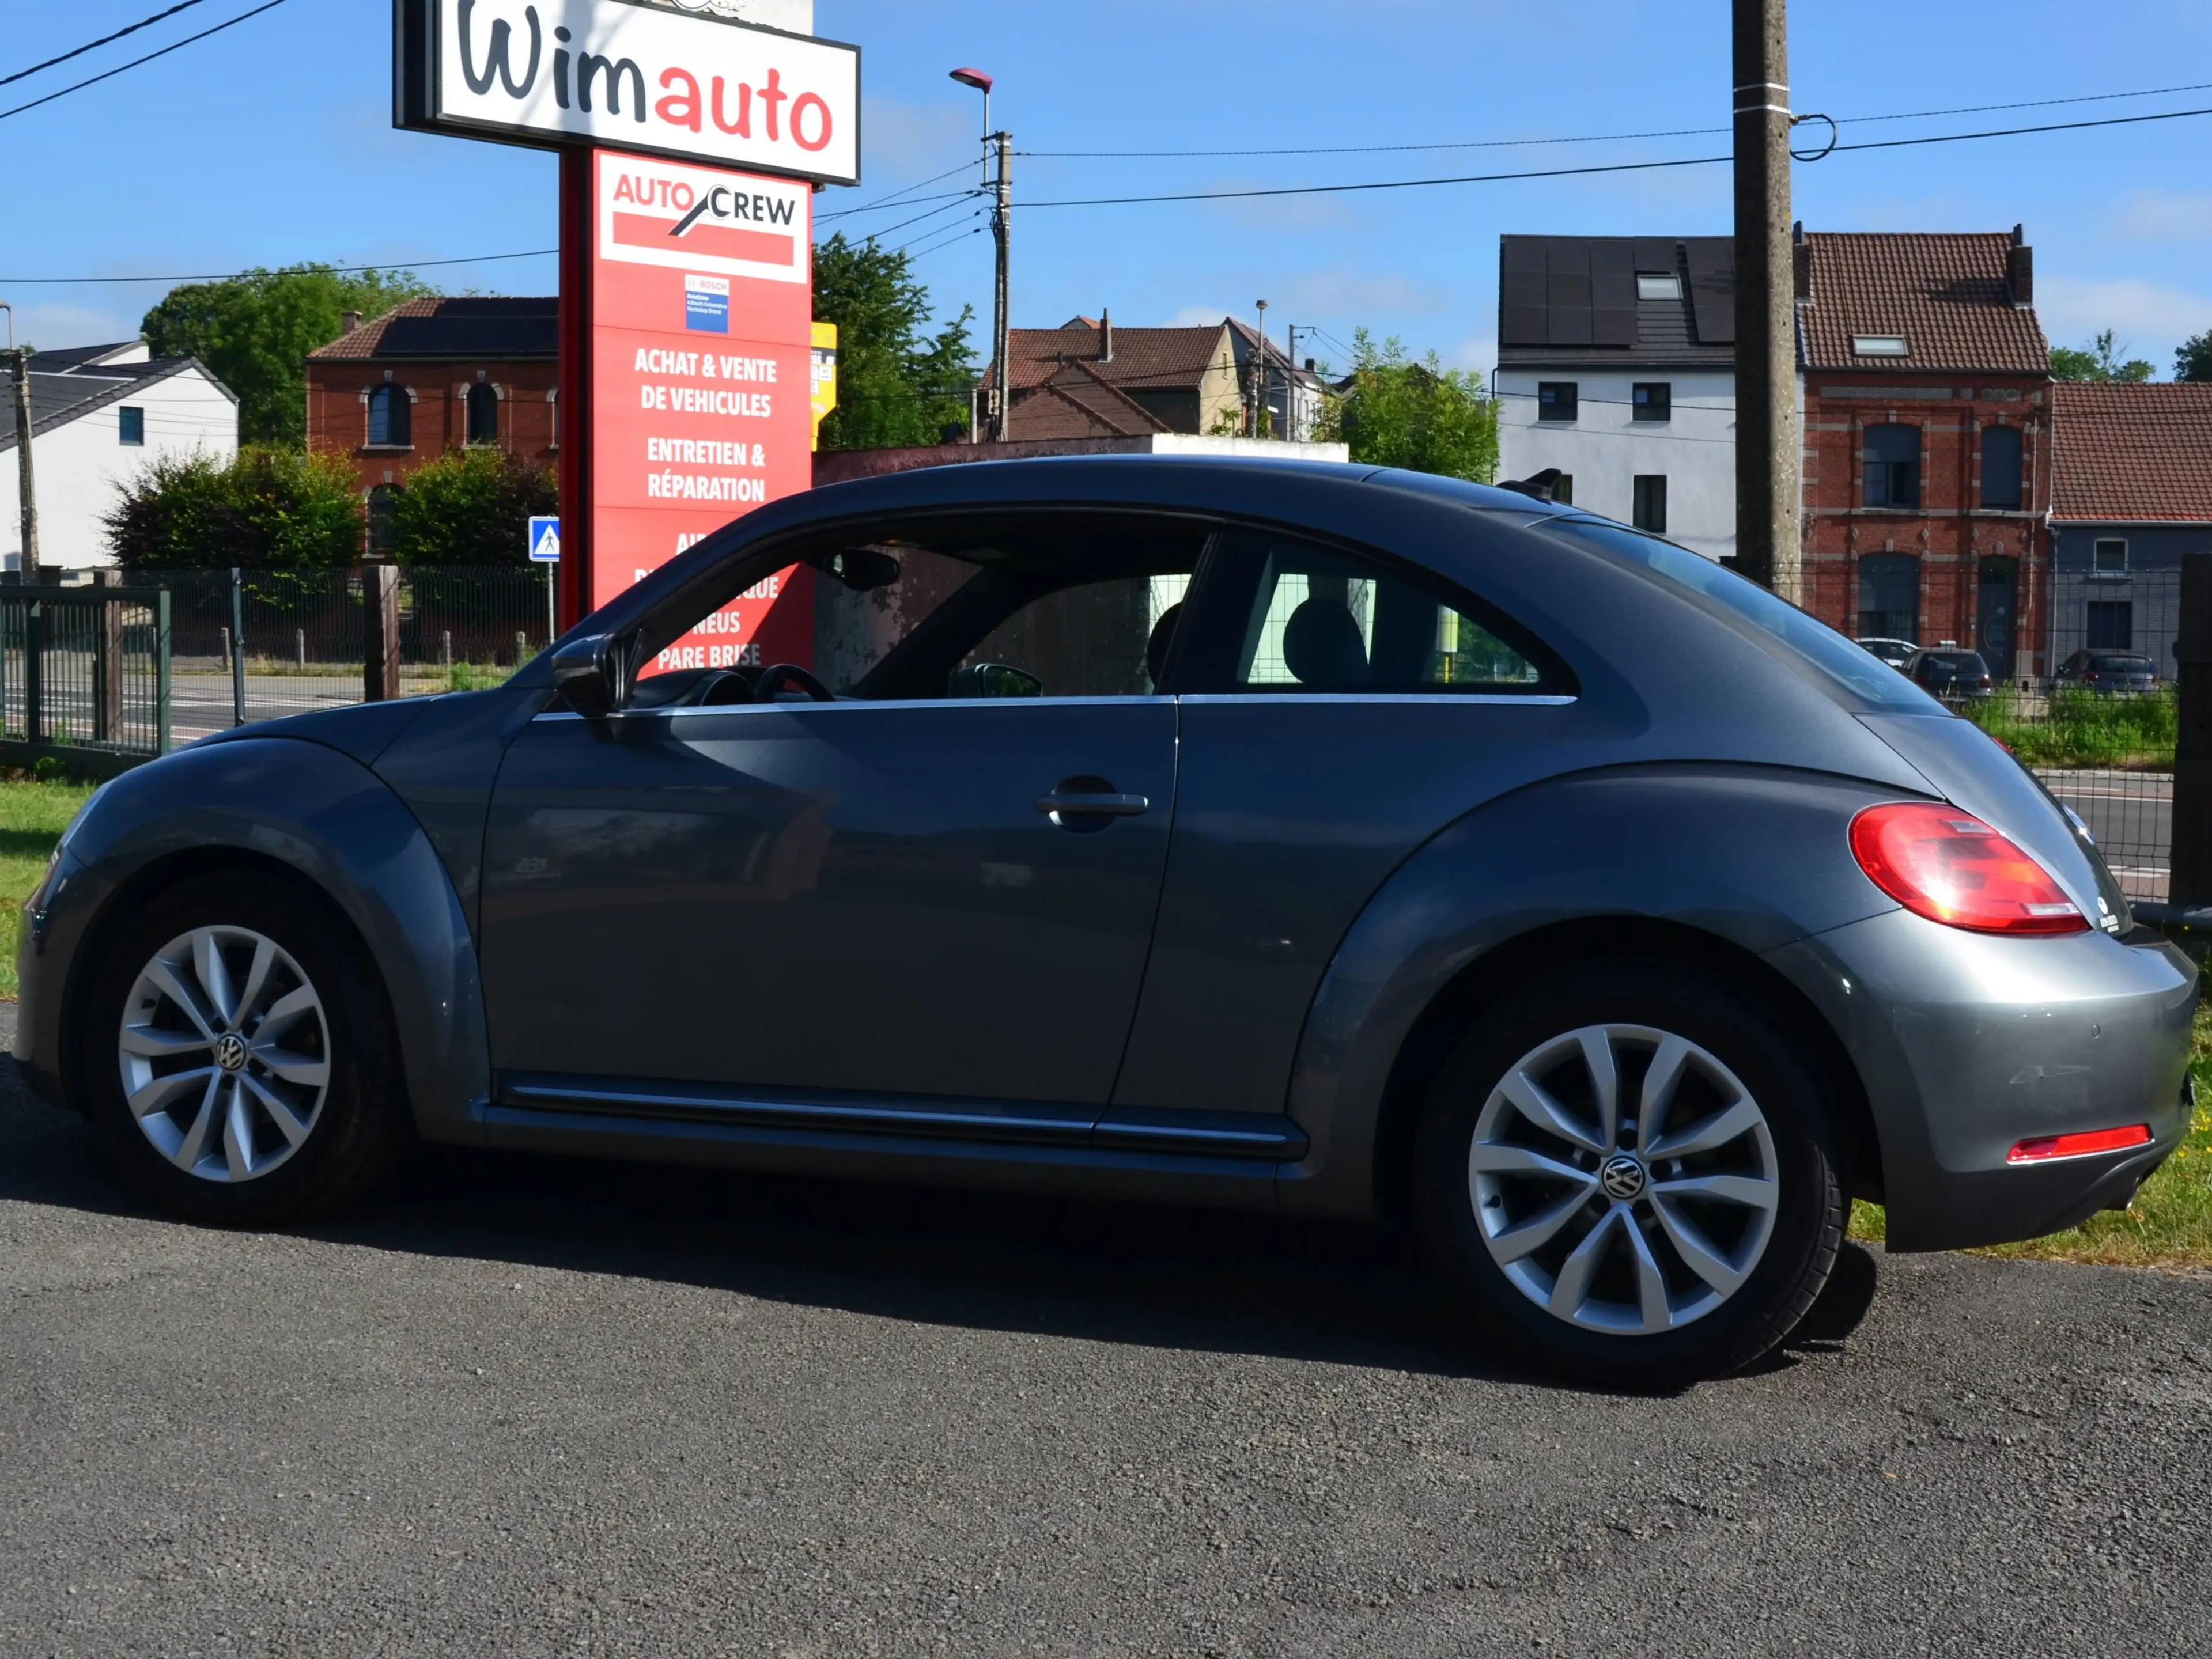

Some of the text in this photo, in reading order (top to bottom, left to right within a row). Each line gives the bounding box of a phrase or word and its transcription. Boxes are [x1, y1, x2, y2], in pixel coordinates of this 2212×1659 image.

[458, 0, 832, 151] Wimauto
[613, 174, 796, 226] AUTO CREW
[699, 281, 727, 290] BOSCH
[634, 348, 777, 382] ACHAT & VENTE
[641, 385, 771, 418] DE VEHICULES
[648, 437, 766, 467] ENTRETIEN &
[648, 468, 765, 502] RÉPARATION
[693, 612, 740, 634] NEUS
[658, 643, 761, 670] PARE BRISE
